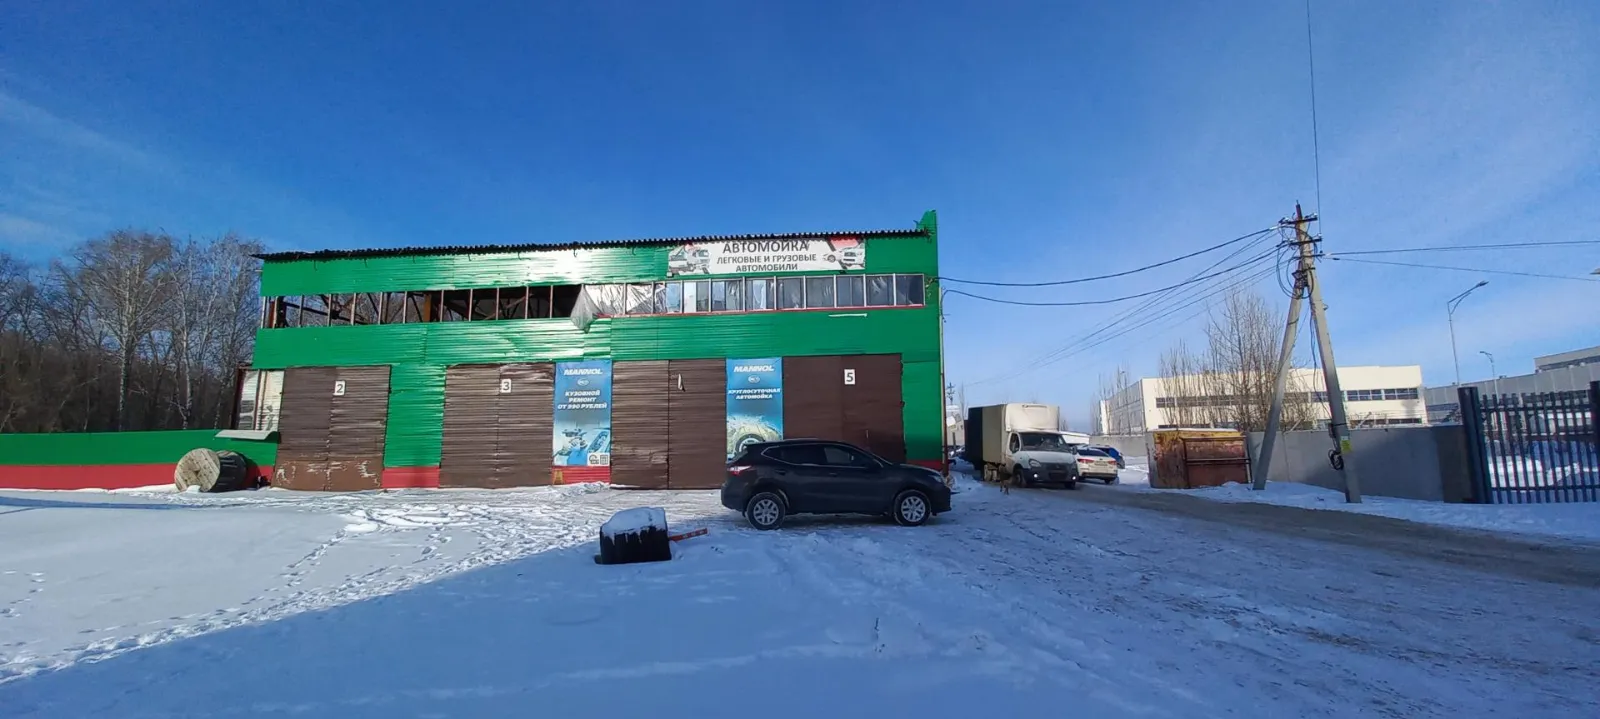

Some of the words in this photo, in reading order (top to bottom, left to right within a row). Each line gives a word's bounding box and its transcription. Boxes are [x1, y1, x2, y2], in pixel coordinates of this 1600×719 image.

[717, 255, 761, 264] ЛЕГКОВЫЕ
[764, 255, 770, 263] И
[772, 254, 817, 263] ГРУЗОВЫЕ
[735, 263, 798, 272] АВТОМОБИЛИ
[563, 368, 603, 376] MANNOL
[733, 365, 775, 373] MANNOL
[846, 372, 854, 382] 5
[336, 383, 344, 393] 2
[502, 381, 510, 391] 3
